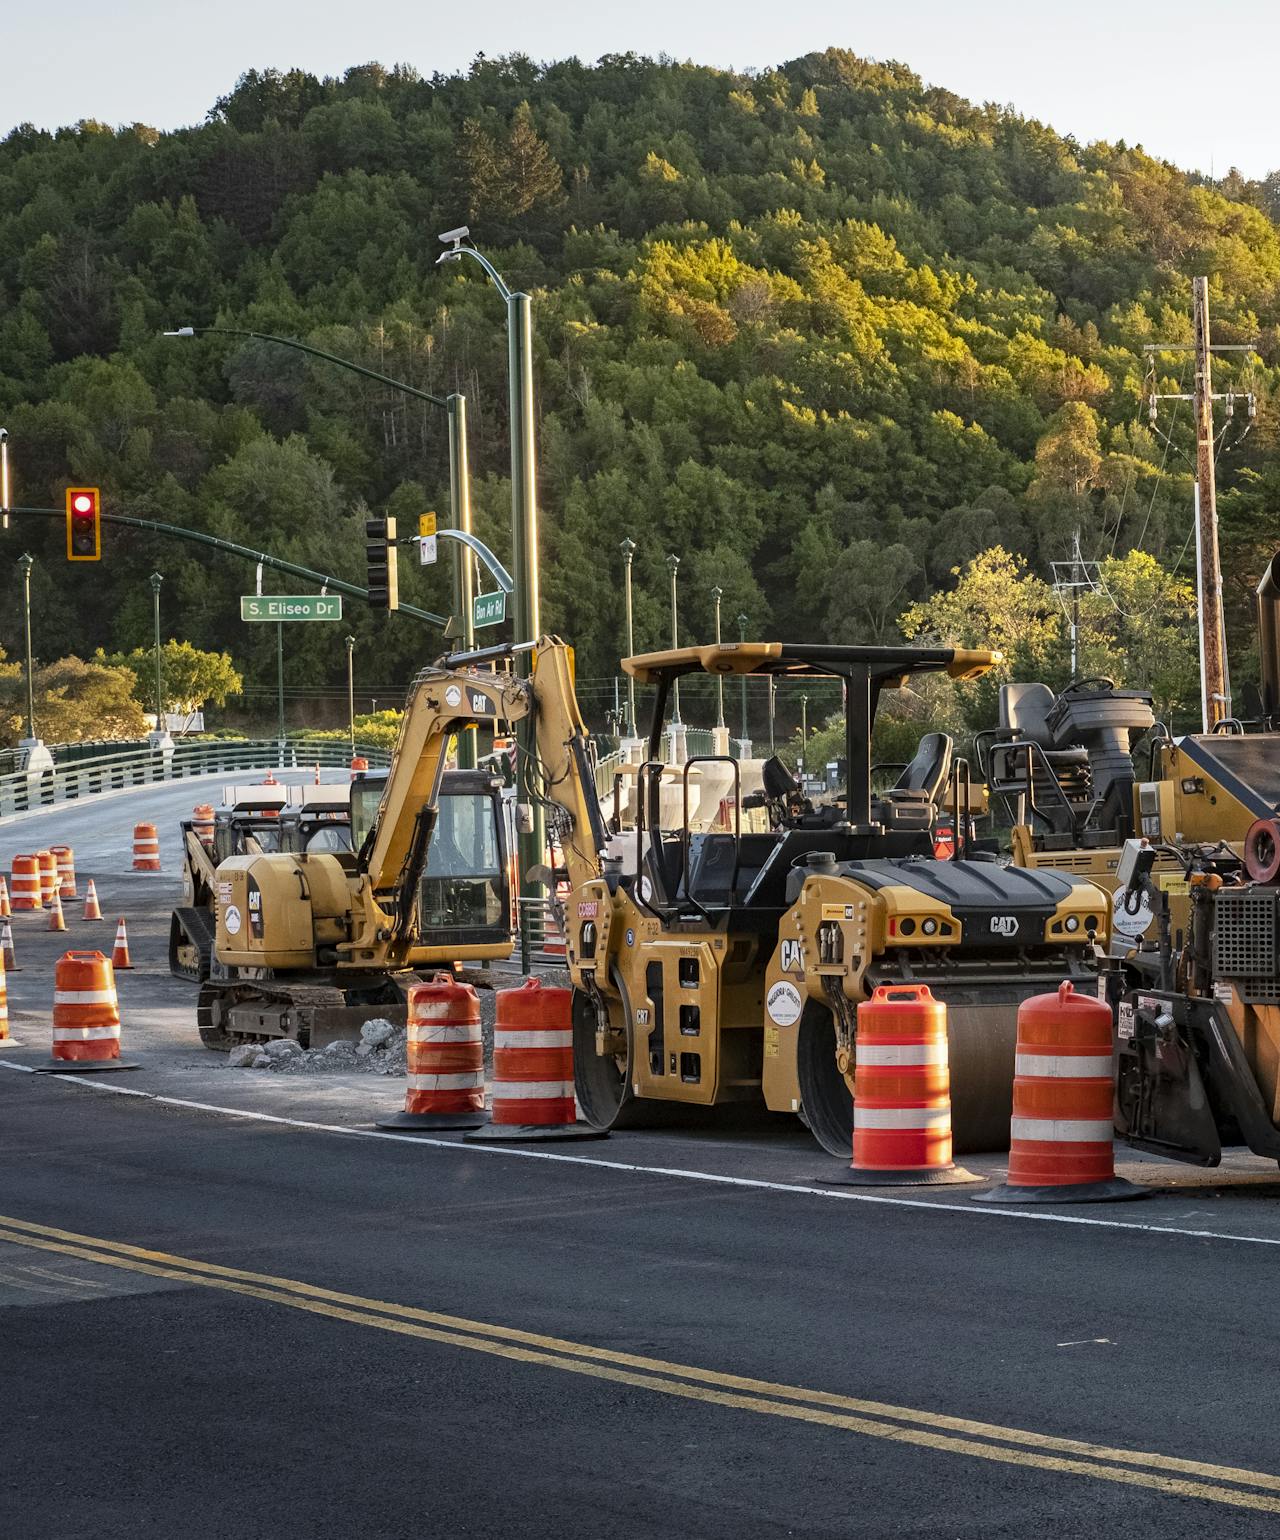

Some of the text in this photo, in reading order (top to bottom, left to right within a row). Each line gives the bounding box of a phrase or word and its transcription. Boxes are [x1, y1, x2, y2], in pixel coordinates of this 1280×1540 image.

[249, 602, 334, 615] S. Eliseo Dr
[476, 600, 503, 620] Bon Air Rd
[473, 695, 487, 713] CAT
[249, 892, 261, 911] CAT
[990, 916, 1011, 933] CAT
